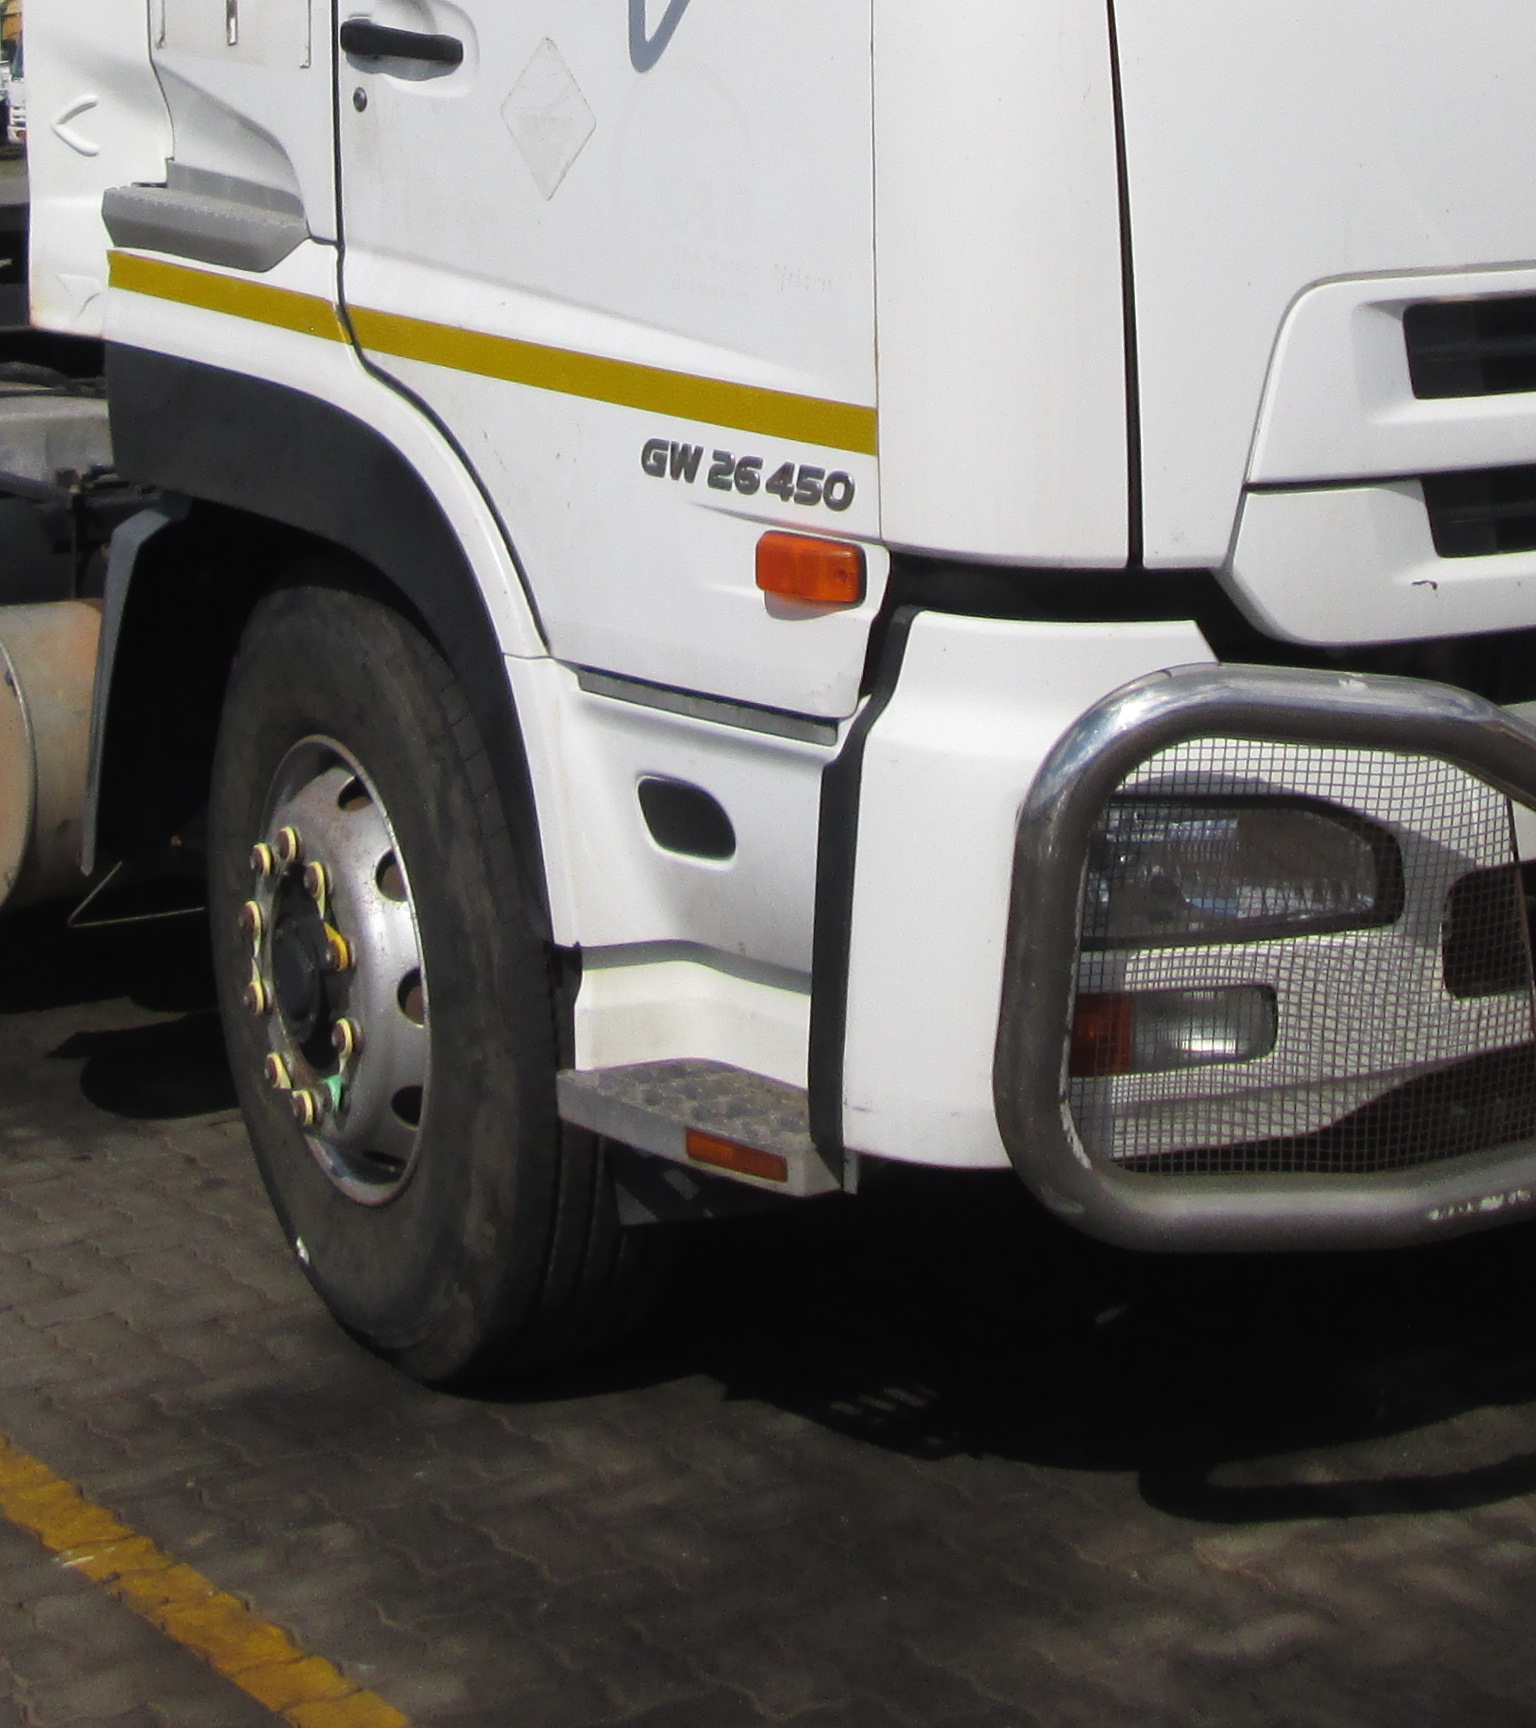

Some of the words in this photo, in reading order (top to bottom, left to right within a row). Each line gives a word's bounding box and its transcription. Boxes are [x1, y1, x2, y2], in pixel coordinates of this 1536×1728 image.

[641, 437, 704, 484] GW
[707, 448, 764, 496] 26
[765, 460, 856, 512] 450
